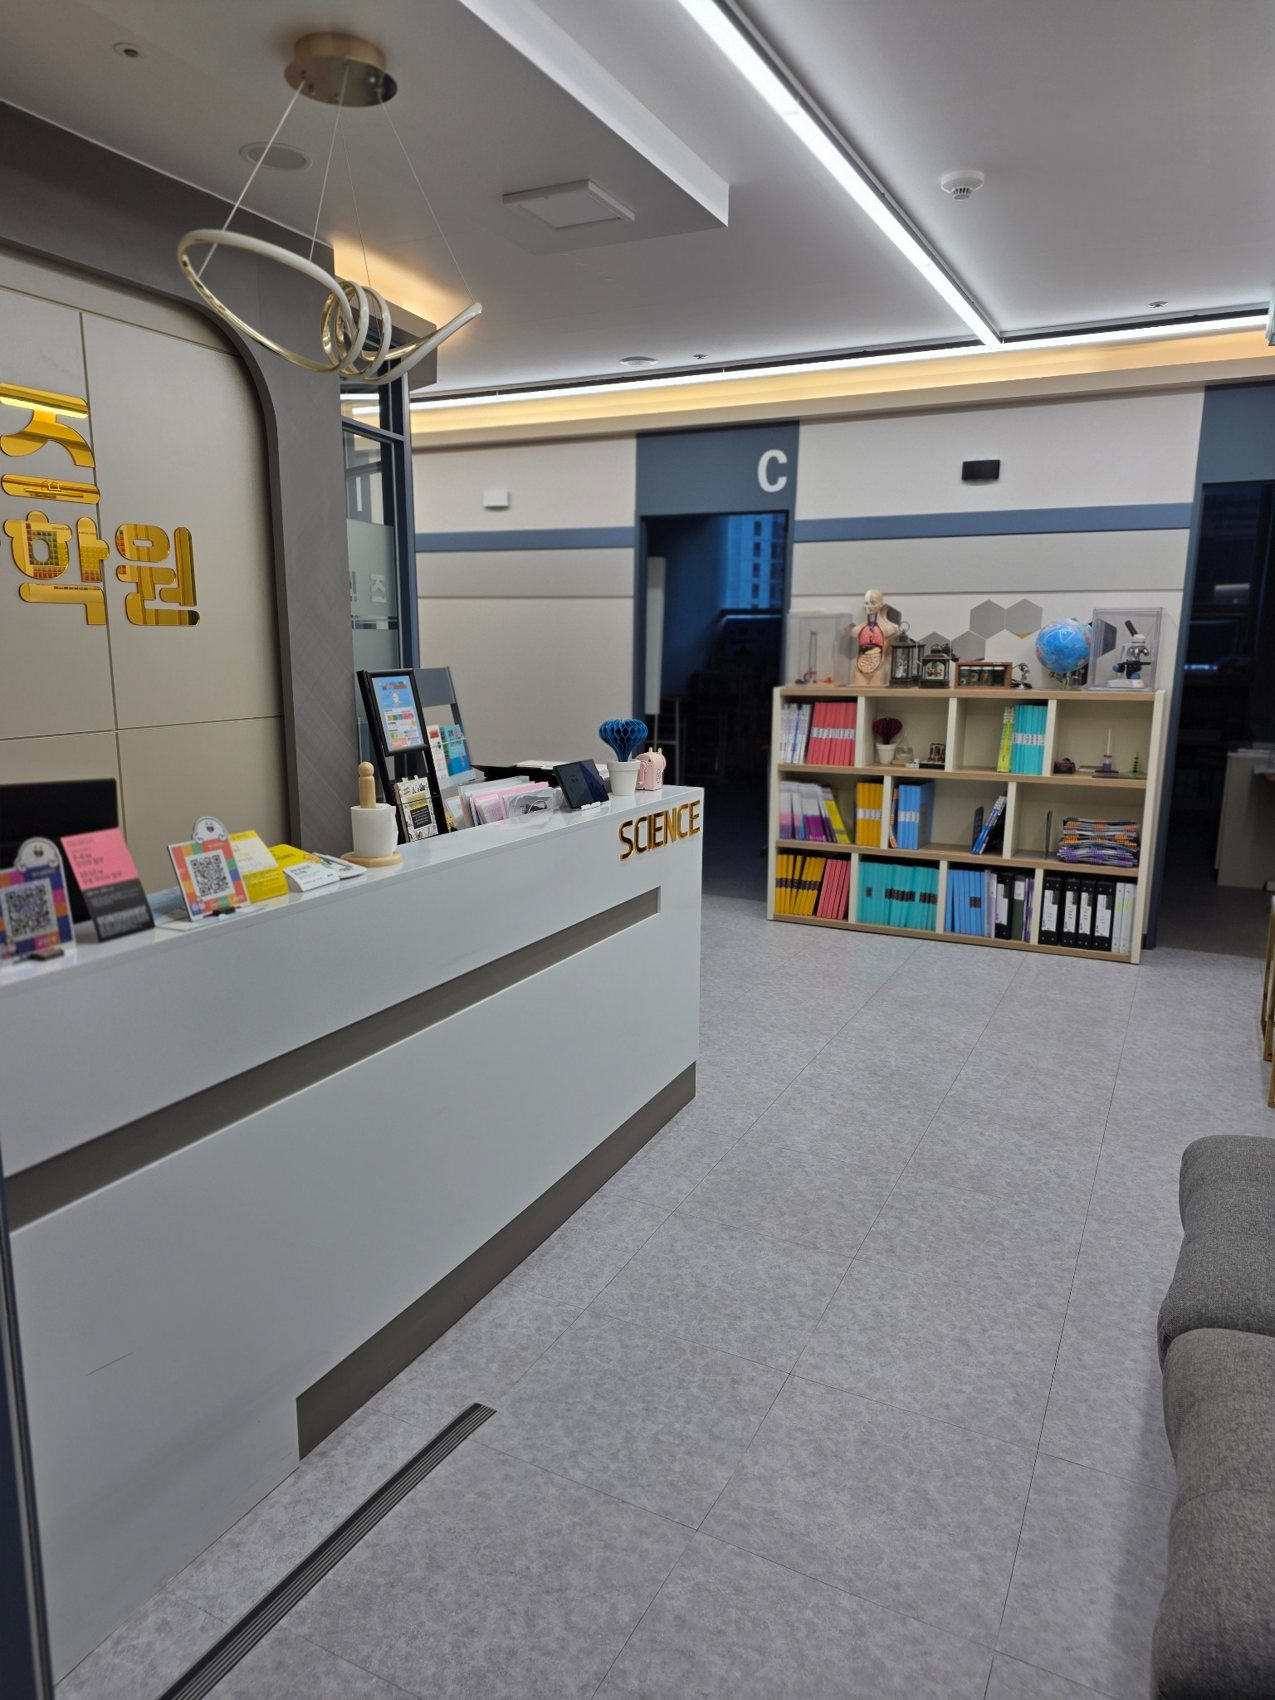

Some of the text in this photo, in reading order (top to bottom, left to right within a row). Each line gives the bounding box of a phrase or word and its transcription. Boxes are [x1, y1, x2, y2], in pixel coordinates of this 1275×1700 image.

[757, 449, 788, 493] C
[3, 510, 200, 626] 학원
[618, 799, 701, 861] SCIENCE
